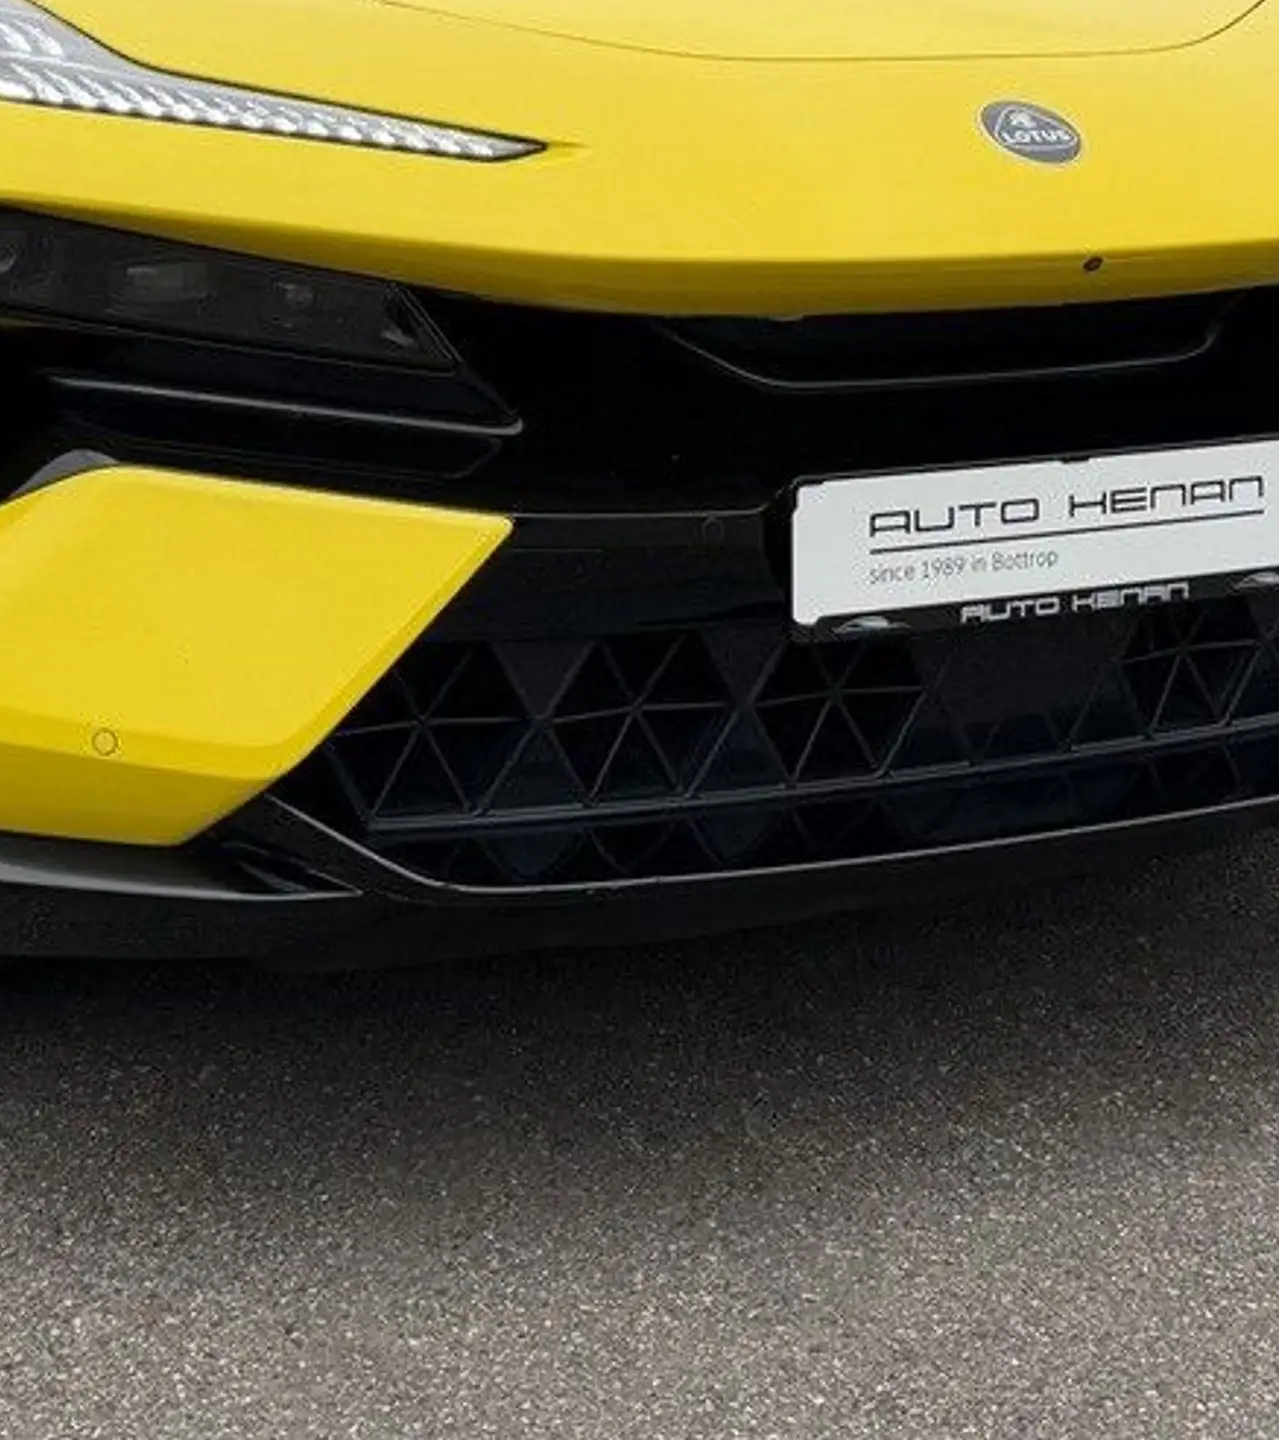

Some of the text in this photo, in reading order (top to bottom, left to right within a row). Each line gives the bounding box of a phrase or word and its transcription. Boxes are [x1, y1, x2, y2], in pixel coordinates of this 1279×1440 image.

[869, 475, 1264, 537] AUTO KENAN
[868, 548, 1060, 585] since 1989 in Bottrop
[960, 582, 1190, 624] AUTO KENAN
